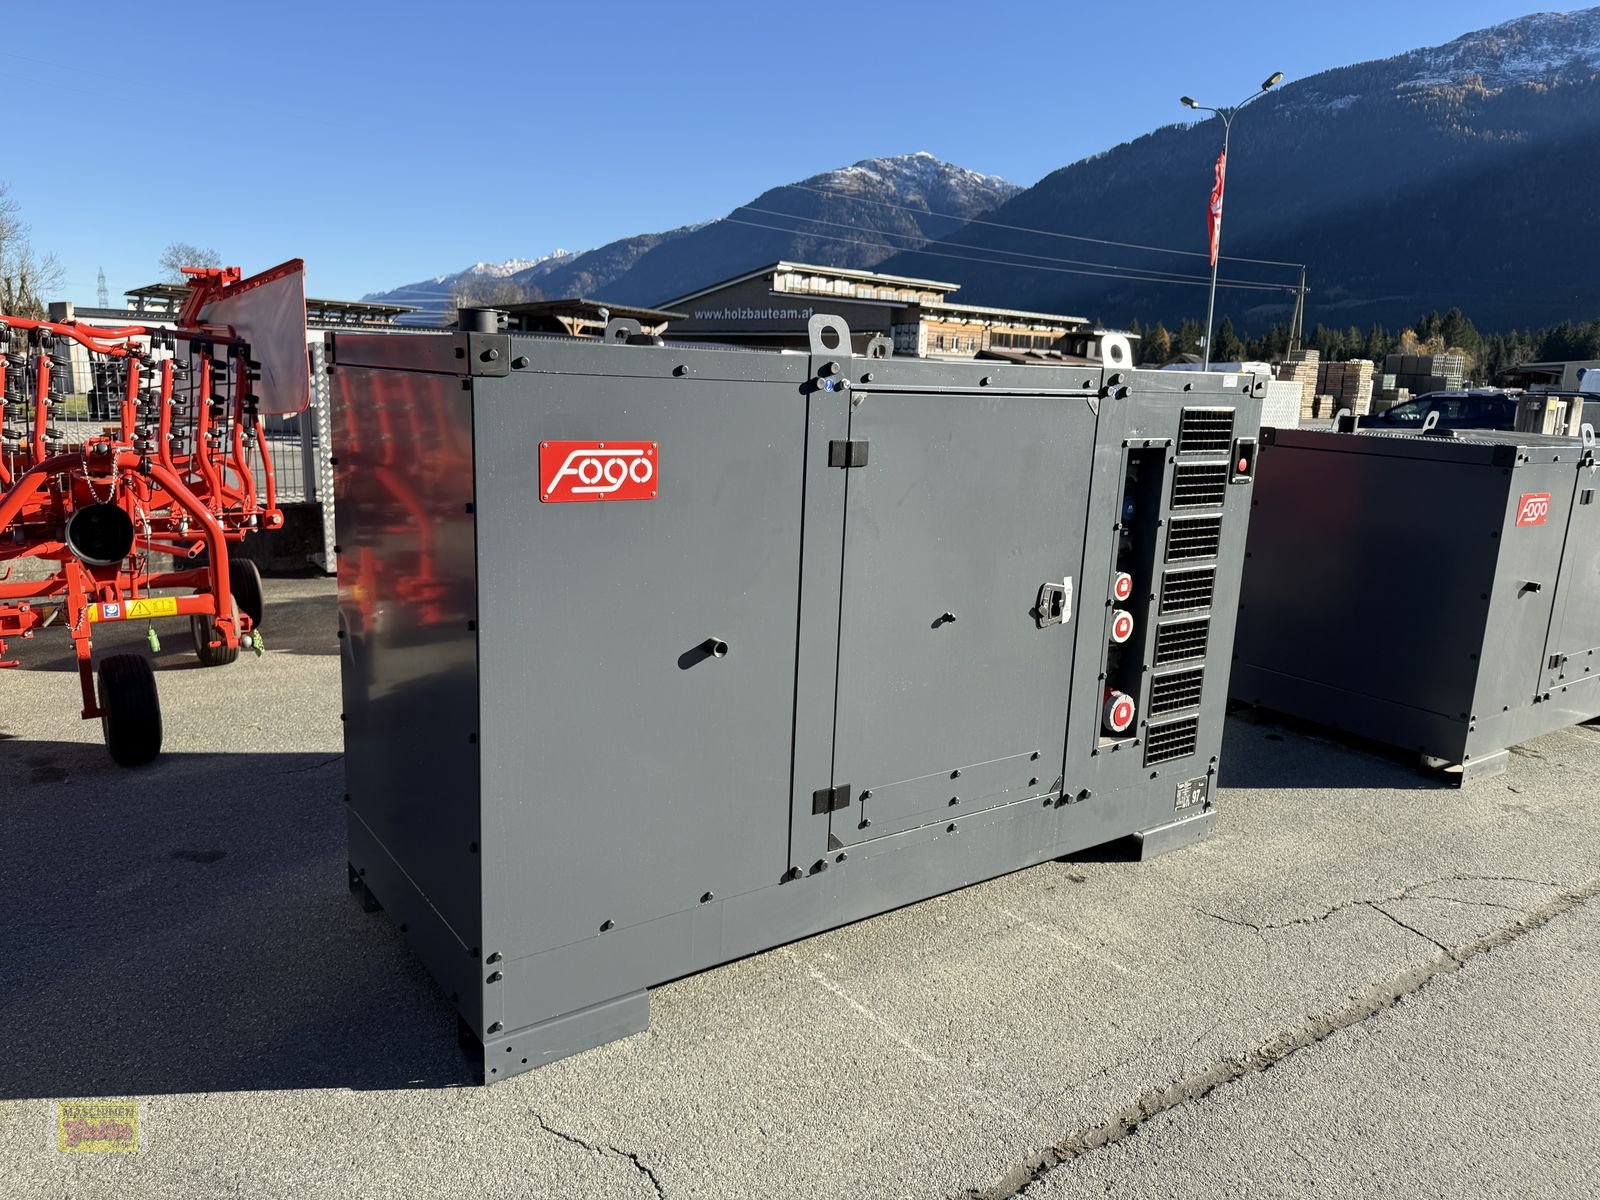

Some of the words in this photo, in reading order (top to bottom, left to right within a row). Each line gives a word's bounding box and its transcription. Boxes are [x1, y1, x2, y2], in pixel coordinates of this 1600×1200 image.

[694, 307, 814, 320] www.holzbauteam.at
[546, 449, 653, 494] Fogo
[1191, 788, 1201, 804] 97
